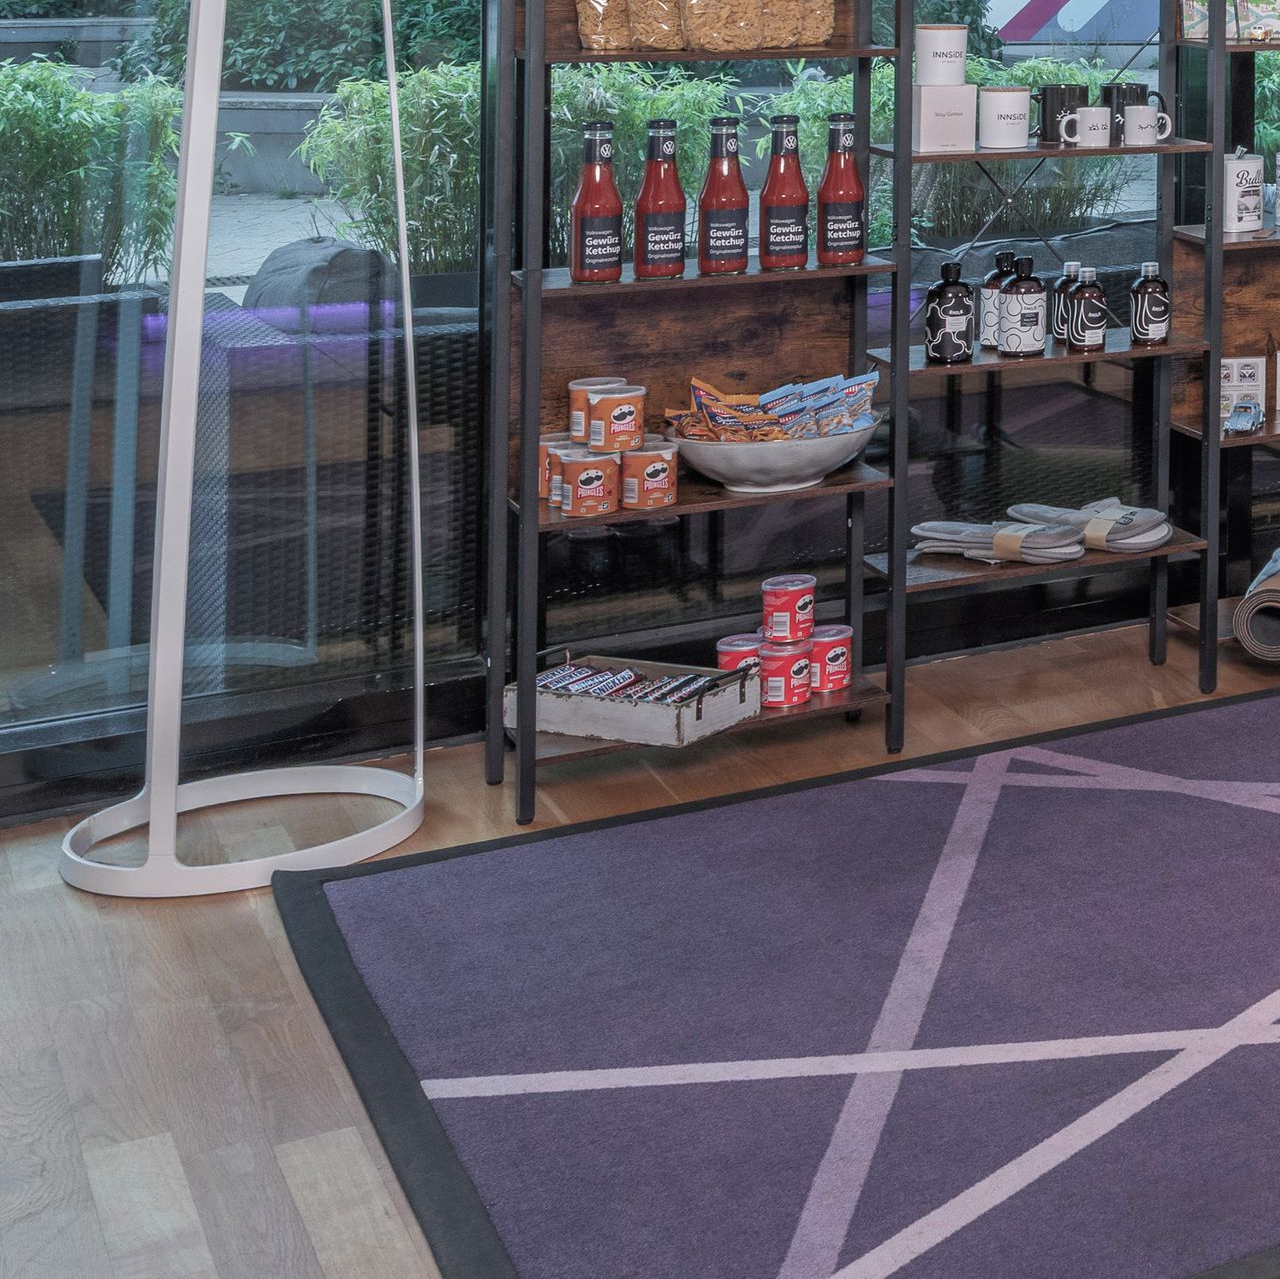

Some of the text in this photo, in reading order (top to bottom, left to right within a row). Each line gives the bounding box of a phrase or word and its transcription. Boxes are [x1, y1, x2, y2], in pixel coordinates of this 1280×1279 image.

[770, 224, 802, 234] Gewürz
[827, 220, 859, 230] Gewürz
[648, 231, 681, 242] Gewürz
[710, 228, 743, 238] Gewürz
[827, 229, 861, 240] Ketchup
[585, 236, 619, 246] Gewürz
[710, 237, 745, 247] Ketchup
[770, 234, 805, 244] Ketchup
[585, 246, 621, 256] Ketchup
[648, 241, 683, 252] Ketchup
[610, 421, 636, 434] PRINGLES
[644, 478, 669, 491] PRINGLES
[577, 486, 604, 498] PRINGLES
[593, 671, 633, 696] SNICKERS
